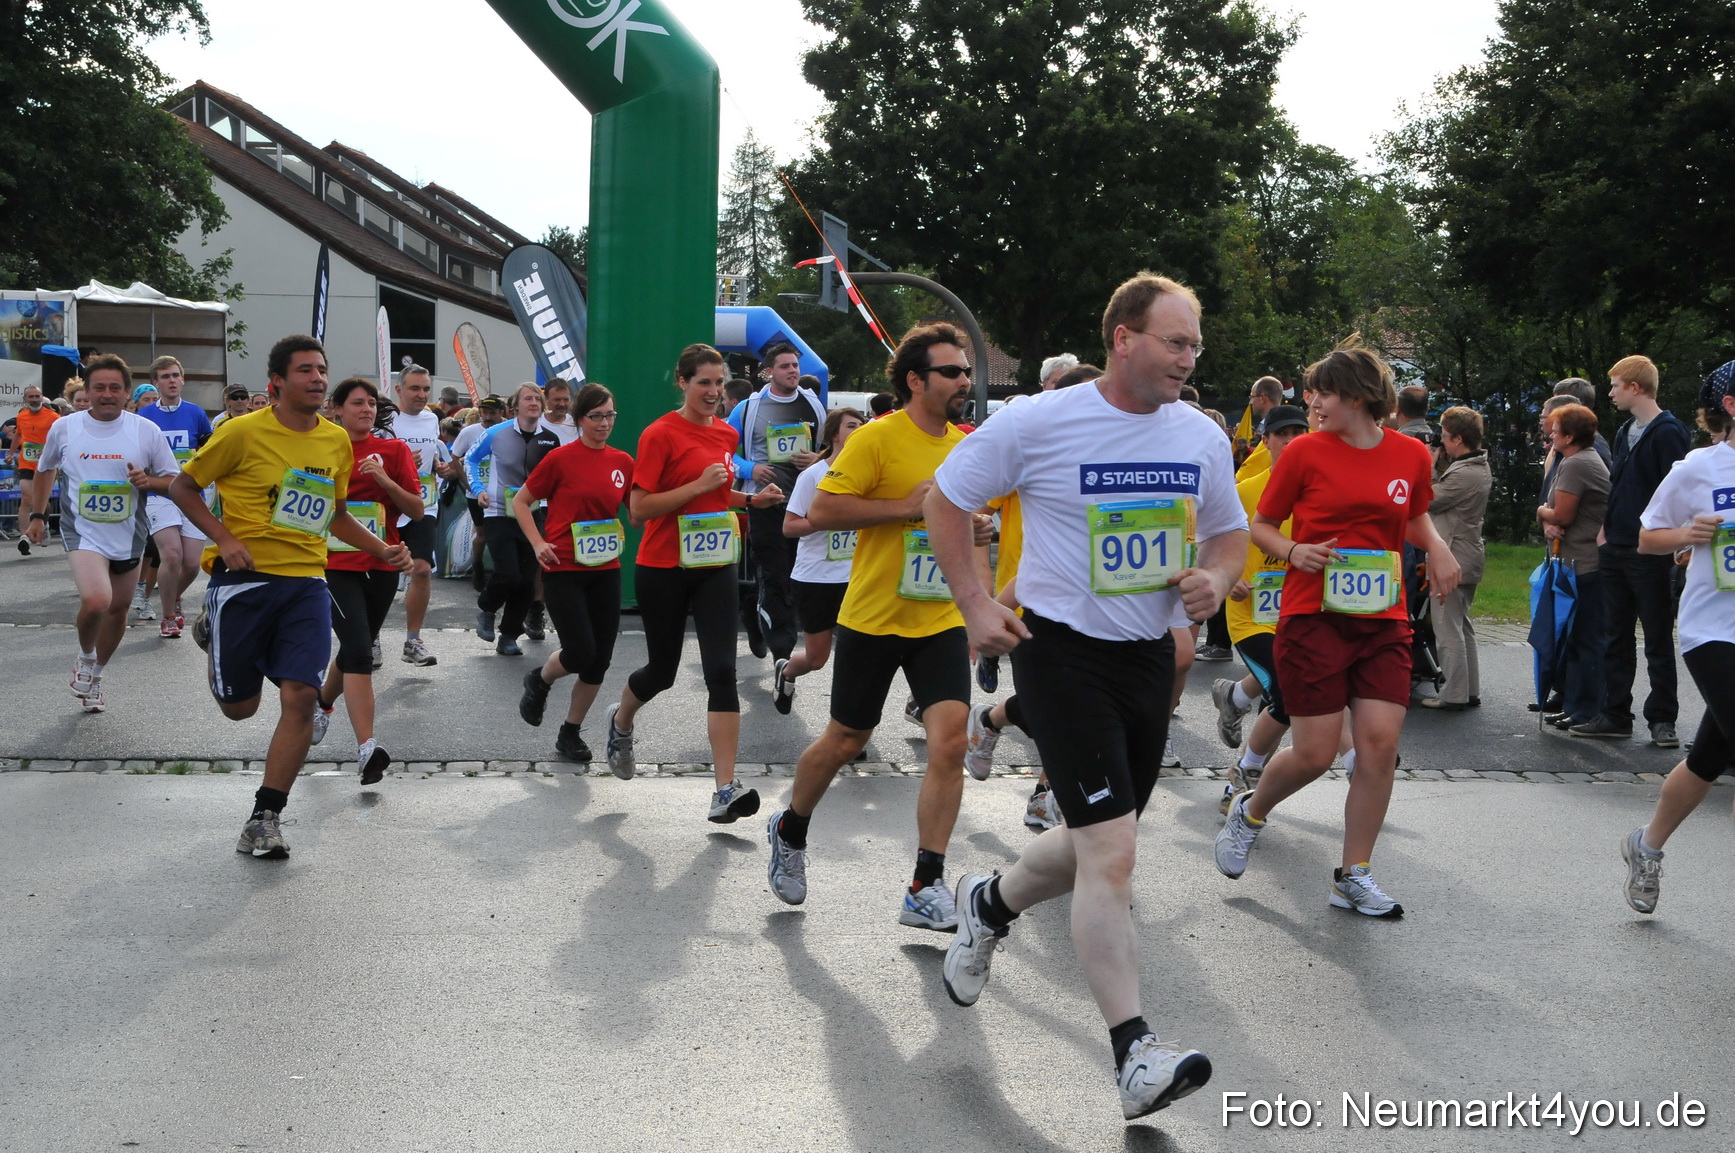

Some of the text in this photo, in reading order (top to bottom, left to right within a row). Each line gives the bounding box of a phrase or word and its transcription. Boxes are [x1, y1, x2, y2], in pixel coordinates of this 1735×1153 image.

[0, 324, 49, 344] gistics
[777, 436, 797, 452] 67
[1101, 471, 1196, 486] STAEDTLER
[84, 494, 124, 512] 493
[281, 489, 326, 520] 209
[577, 535, 618, 555] 1295
[683, 530, 732, 553] 1297
[1101, 530, 1167, 572] 901
[1112, 572, 1137, 581] Xaver
[1329, 572, 1385, 597] 1301
[1259, 589, 1283, 612] 20
